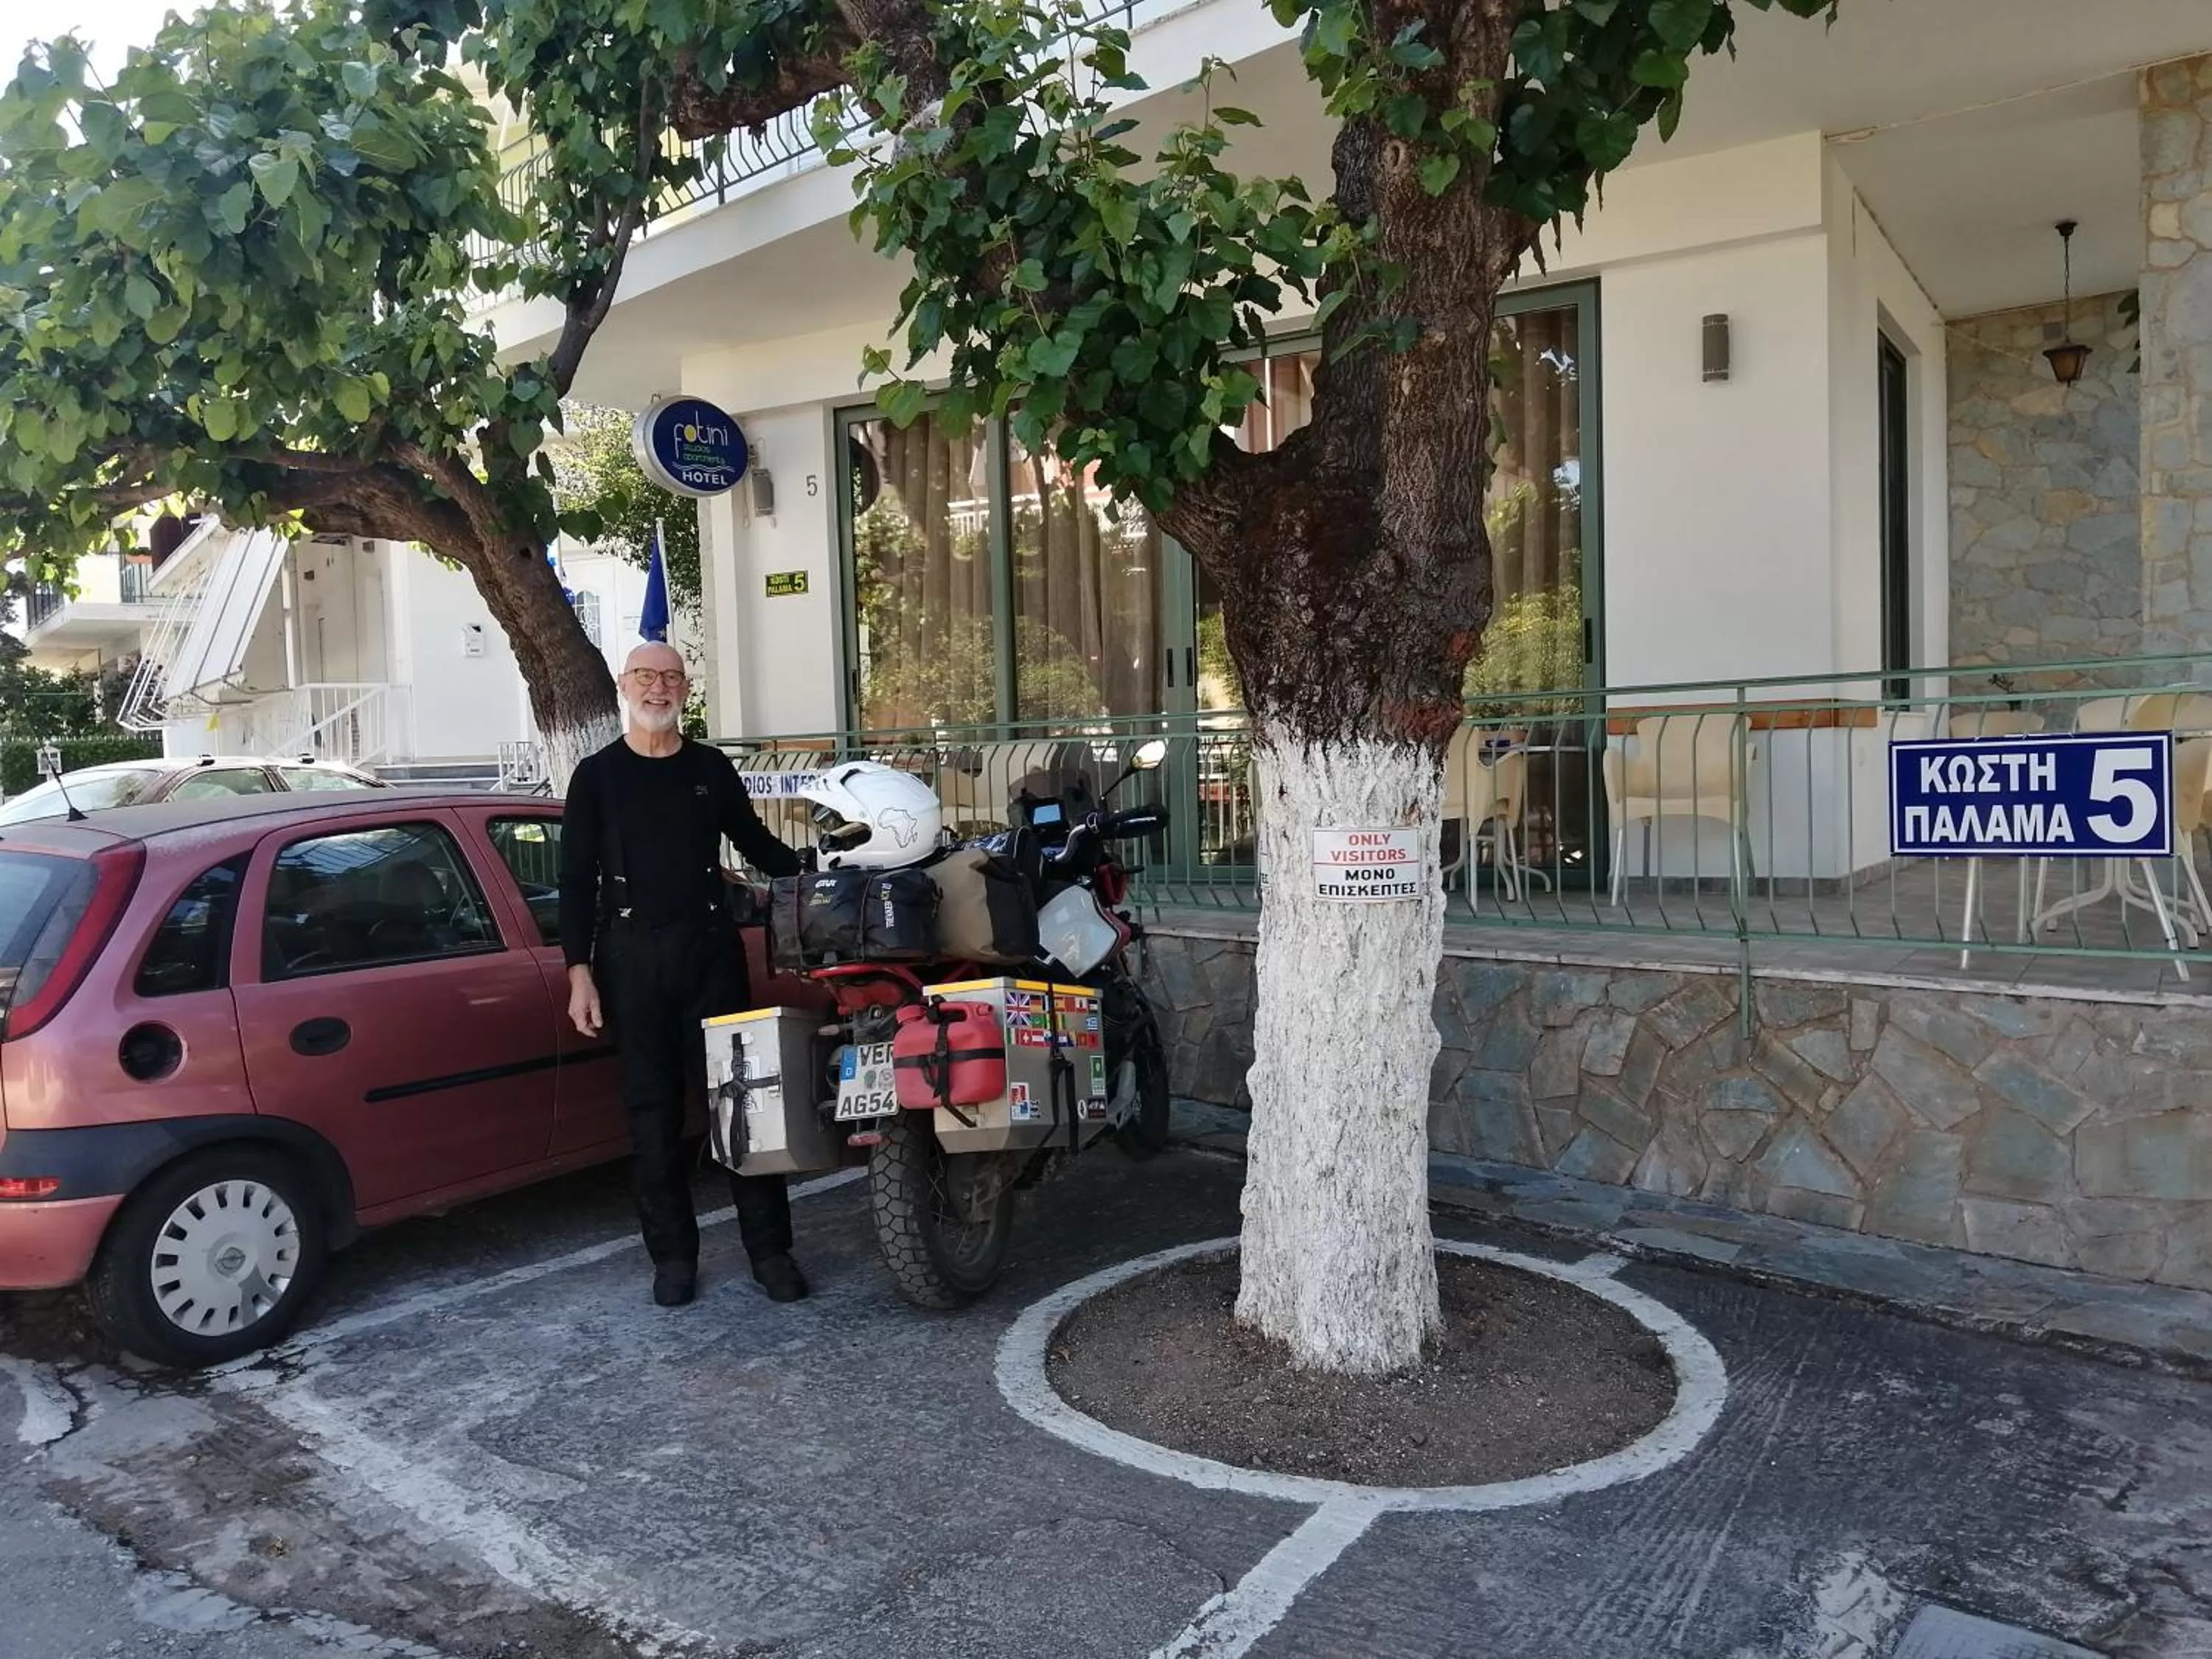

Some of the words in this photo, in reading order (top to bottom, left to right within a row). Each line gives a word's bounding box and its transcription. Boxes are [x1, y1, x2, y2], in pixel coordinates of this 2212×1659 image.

[682, 471, 728, 485] HOTEL
[806, 474, 818, 496] 5
[794, 572, 805, 591] 5
[1920, 752, 2057, 794] ΚΩΣΤΗ
[2087, 747, 2158, 844] 5
[1904, 803, 2076, 844] ΠΑΛΑΜΑ
[1348, 833, 1391, 846] ONLY
[1330, 849, 1407, 862] VISITORS
[1345, 868, 1395, 881] ΜΟΝΟ
[1318, 882, 1416, 897] ΕΠΙΣΚΕΠΤΕΣ
[840, 1091, 895, 1116] AG54
